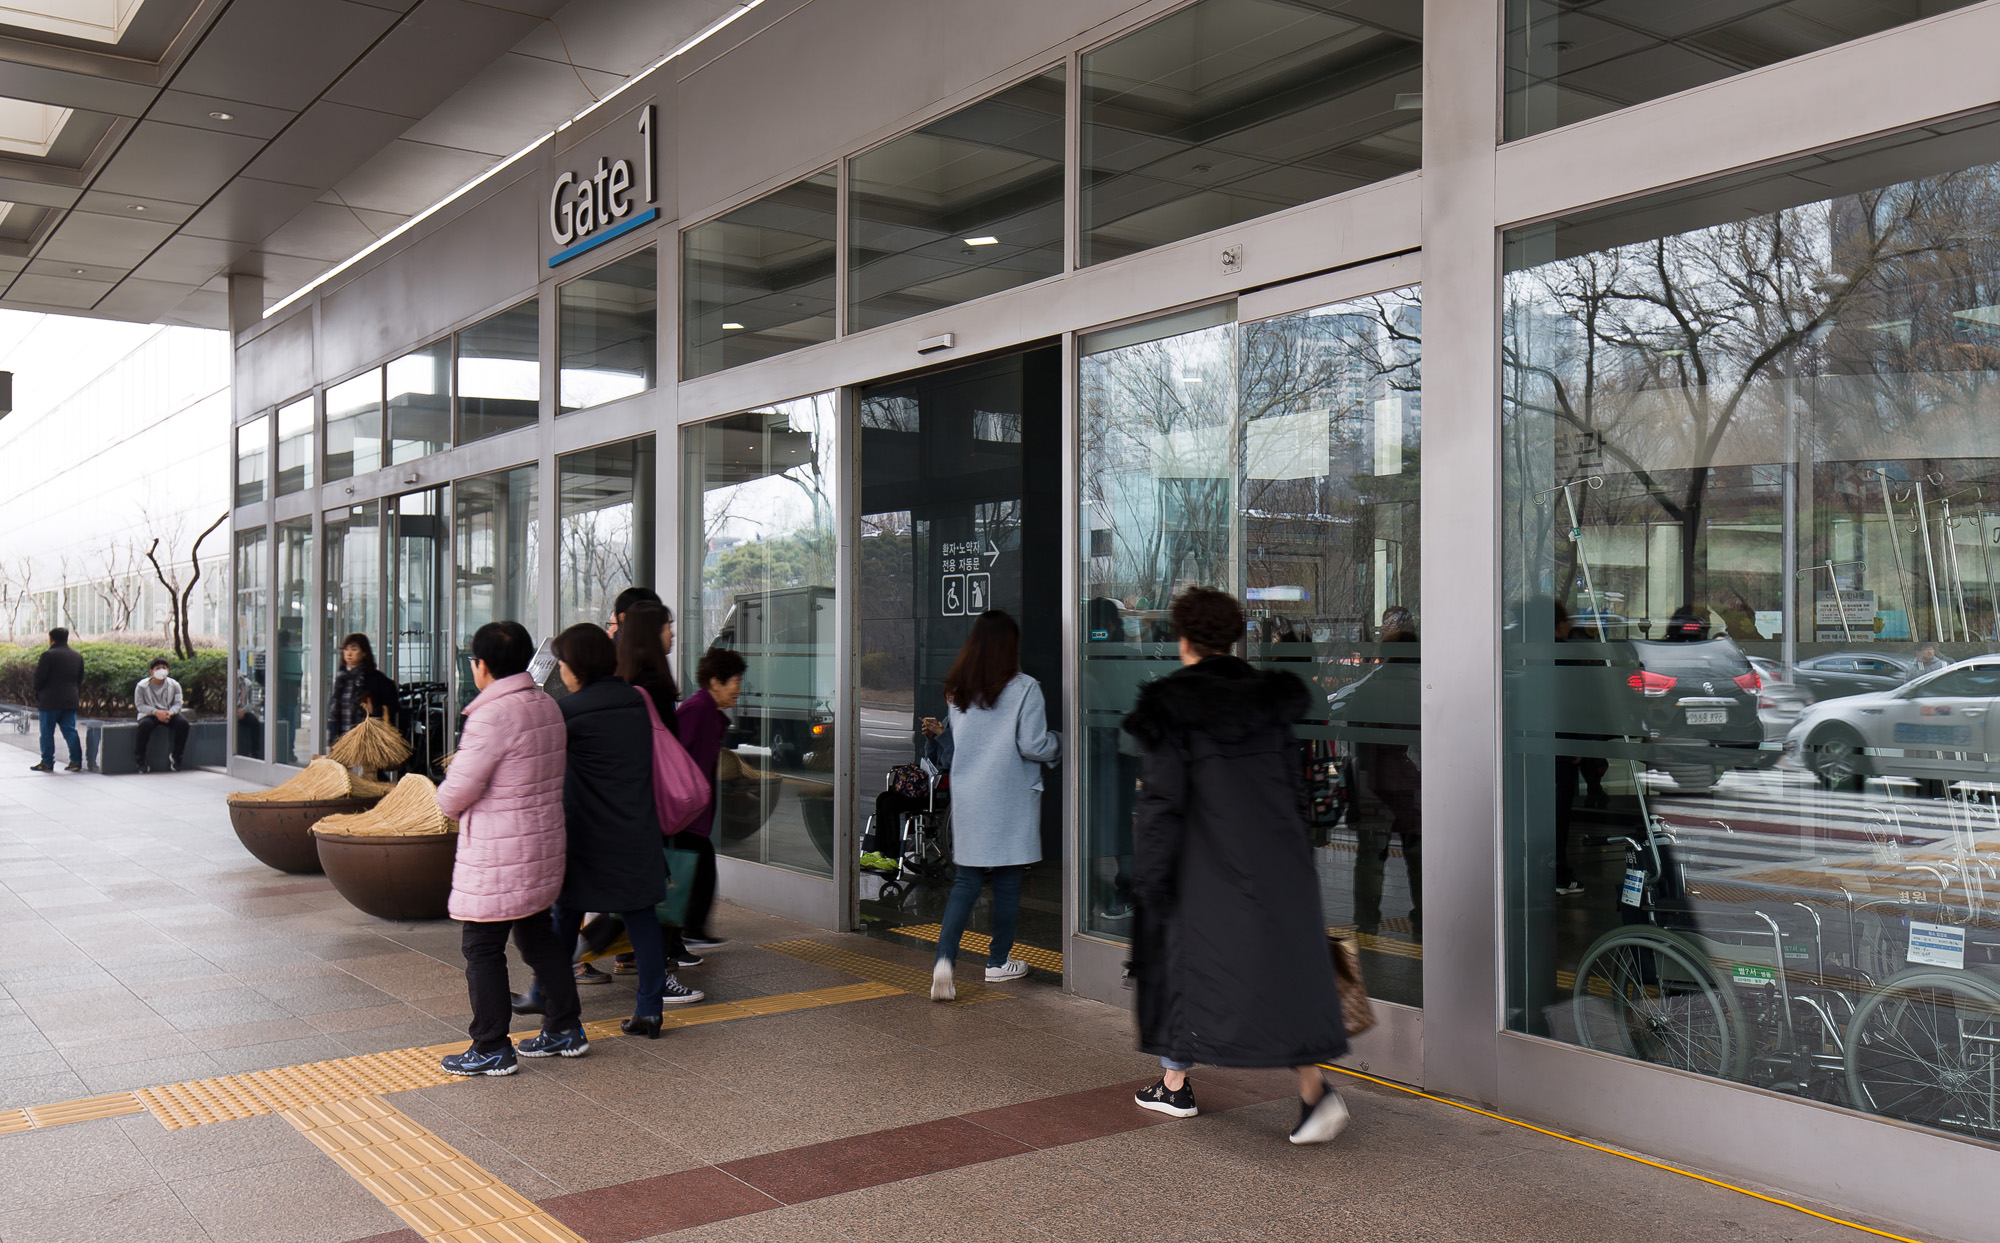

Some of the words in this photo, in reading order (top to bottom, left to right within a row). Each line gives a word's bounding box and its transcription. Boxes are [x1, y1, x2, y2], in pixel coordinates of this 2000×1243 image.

[551, 157, 632, 245] Gate
[638, 105, 656, 203] 1
[942, 541, 980, 556] 환자·노약자
[942, 559, 956, 572] 전용
[958, 557, 980, 571] 자동문
[1898, 890, 1928, 905] 병원
